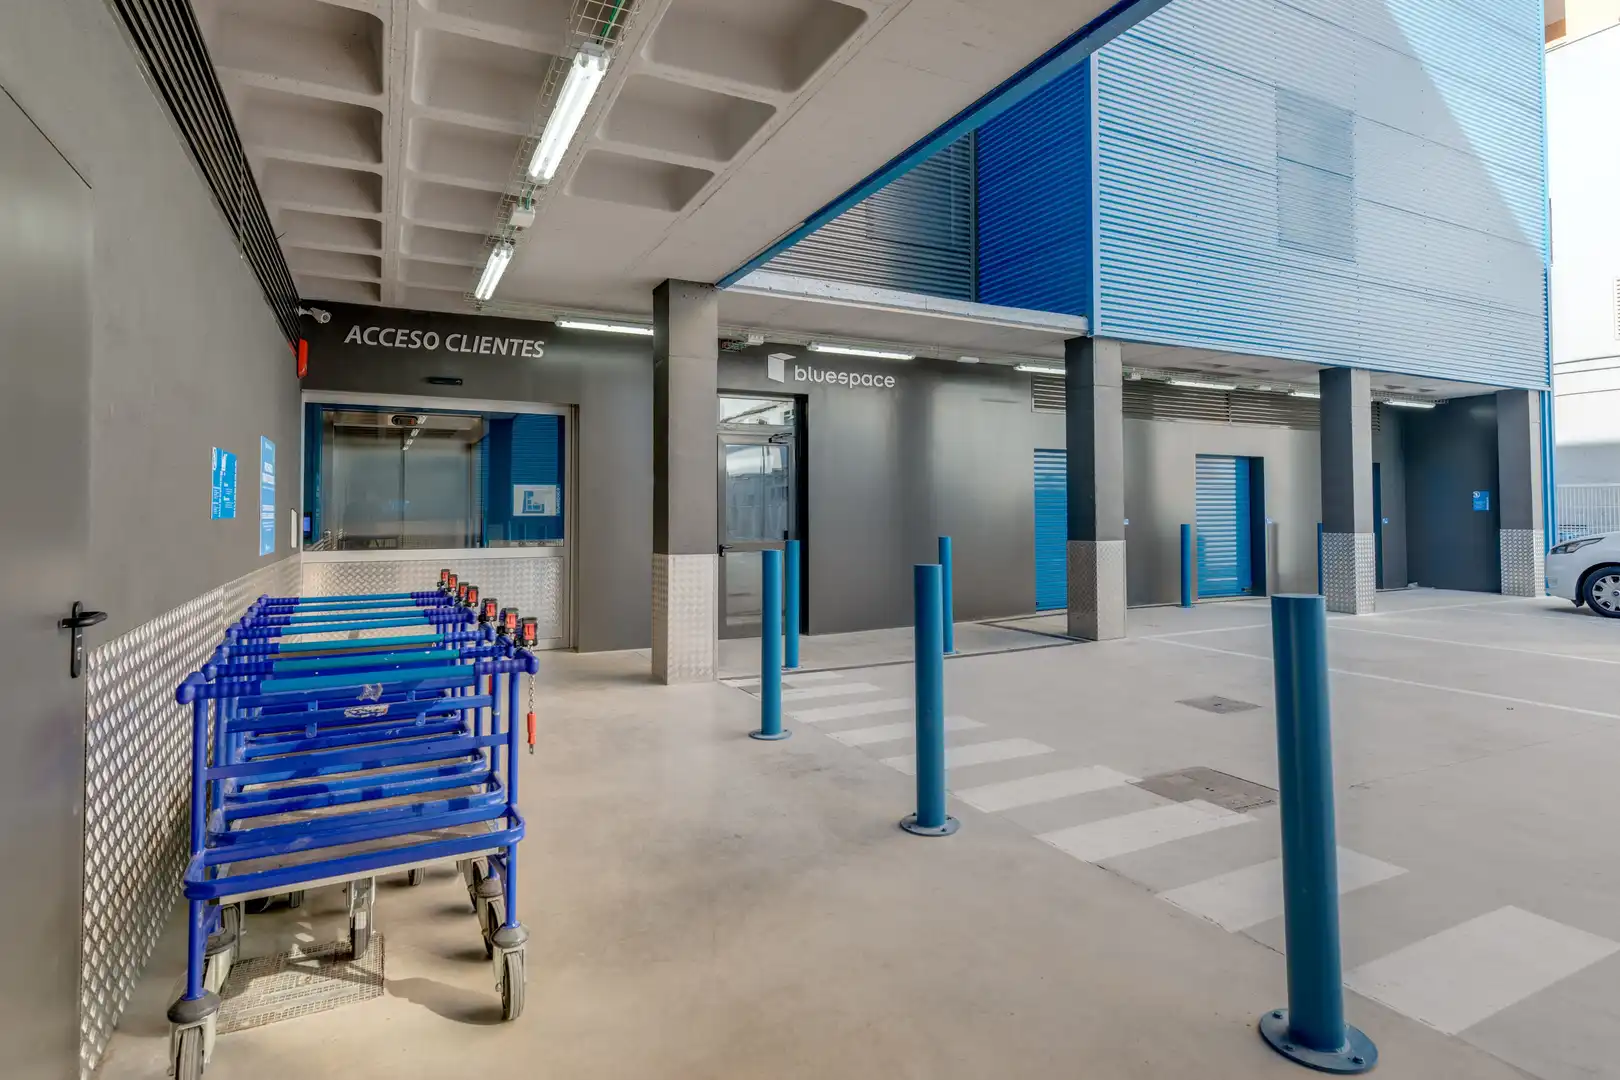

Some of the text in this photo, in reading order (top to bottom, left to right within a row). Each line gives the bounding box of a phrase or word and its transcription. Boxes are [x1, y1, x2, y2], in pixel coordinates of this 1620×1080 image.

[344, 325, 545, 358] ACCESO CLIENTES
[794, 365, 895, 388] bluespace
